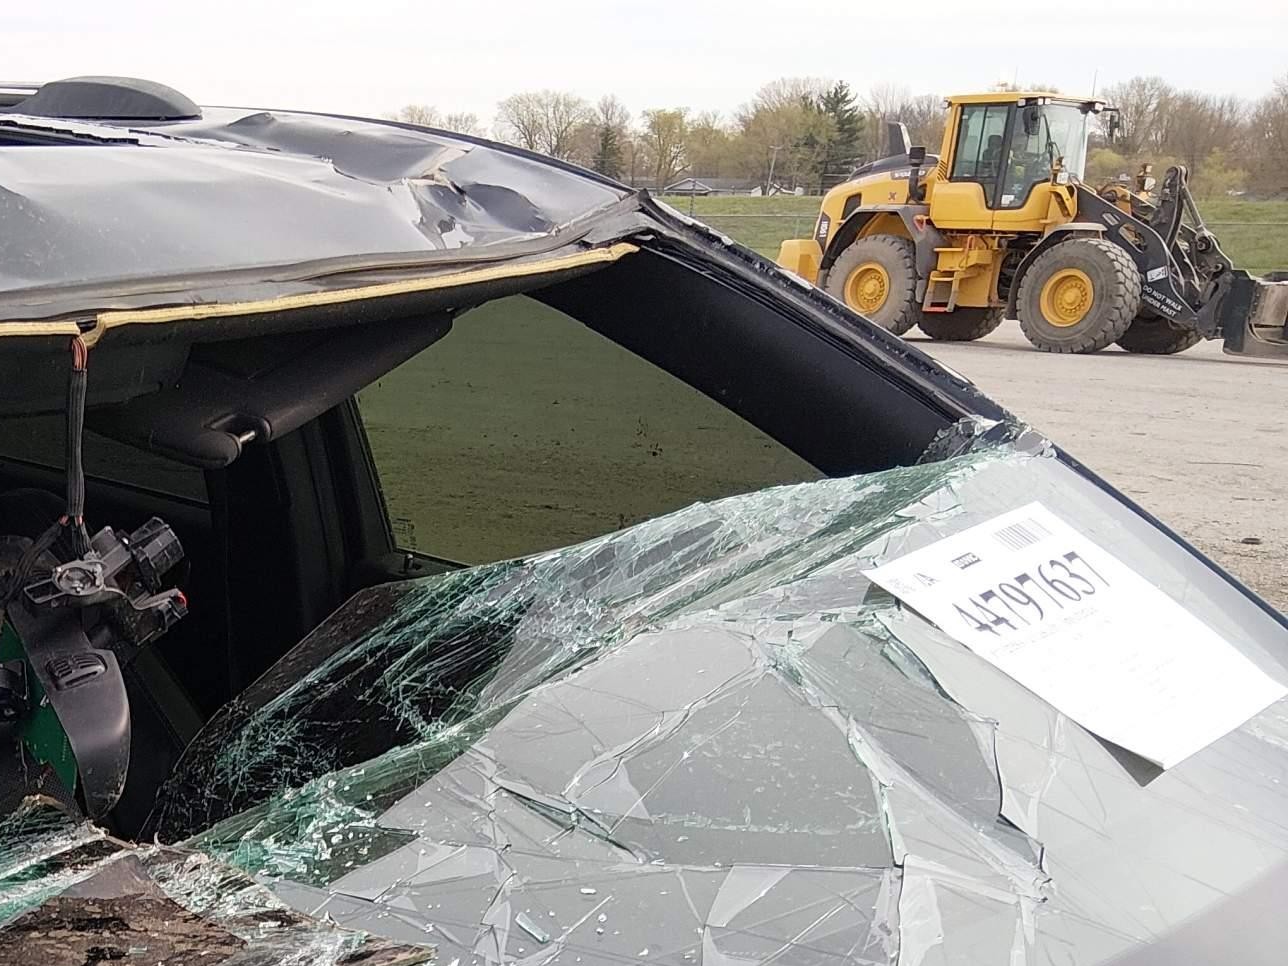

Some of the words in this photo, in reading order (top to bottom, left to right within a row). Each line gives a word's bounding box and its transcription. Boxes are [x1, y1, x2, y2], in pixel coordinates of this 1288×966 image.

[1142, 293, 1161, 308] UNDER
[1160, 305, 1176, 317] MAST
[1143, 285, 1153, 293] DO
[1152, 290, 1166, 300] NOT
[1166, 298, 1182, 311] WALK
[952, 551, 1110, 636] 44797637
